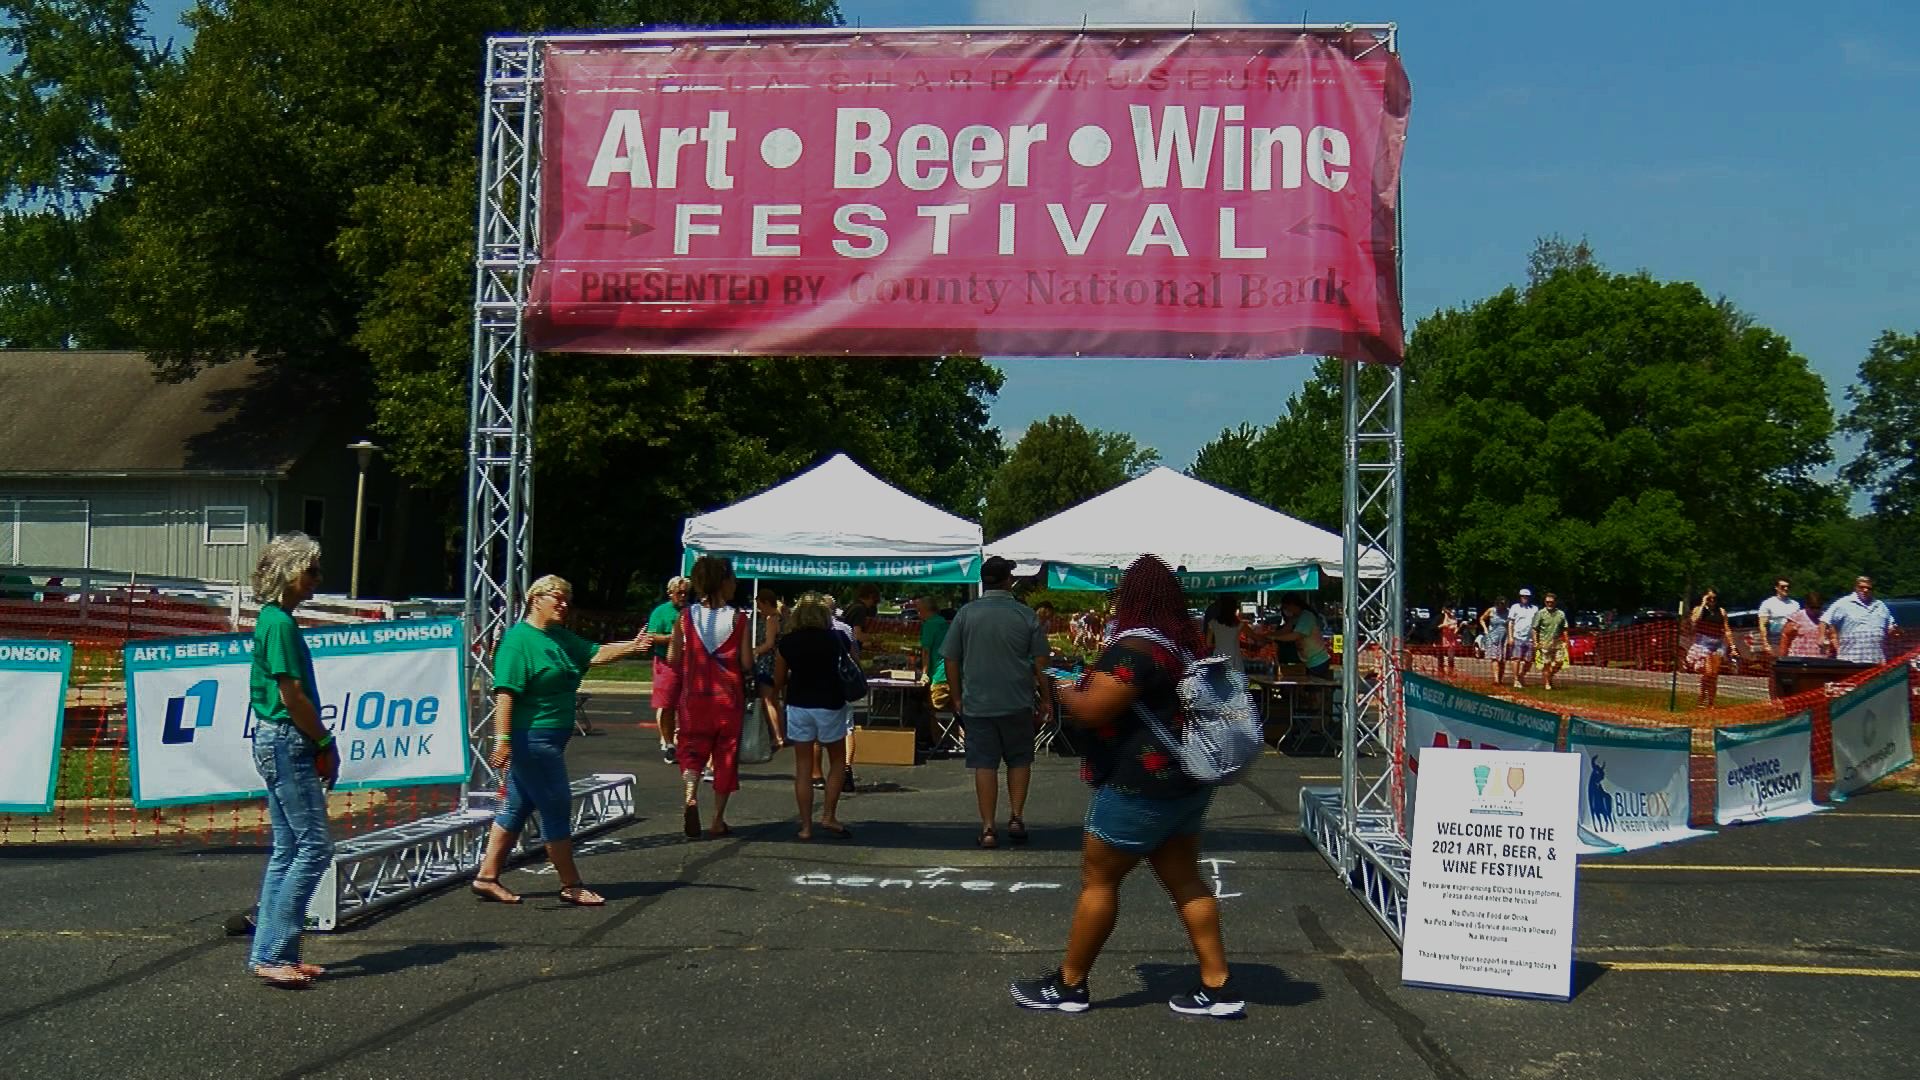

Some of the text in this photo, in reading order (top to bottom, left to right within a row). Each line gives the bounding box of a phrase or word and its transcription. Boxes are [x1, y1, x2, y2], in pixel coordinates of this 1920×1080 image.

[827, 69, 1014, 94] SHARP
[1057, 69, 1300, 92] MUSEUM
[587, 104, 1351, 192] Art Beer Wine
[673, 203, 1268, 258] FESTIVAL
[581, 267, 1352, 314] PRESENTED BY County National Bank
[743, 557, 850, 576] PURCHASED
[856, 561, 869, 576] A
[874, 560, 936, 576] TICKET
[1206, 575, 1217, 589] A
[1222, 572, 1277, 588] TICKET
[304, 624, 454, 648] ESTIVAL SPONSOR
[134, 647, 172, 662] ART,
[1477, 701, 1516, 723] FESTIVAL
[1516, 712, 1557, 734] SPONSOR
[350, 734, 435, 761] BANK
[1727, 758, 1781, 790] experience
[1437, 822, 1555, 841] WELCOME TO THE
[1432, 840, 1462, 854] 2021
[1466, 842, 1497, 859] ART,
[1547, 847, 1557, 861] &
[794, 868, 1061, 893] center
[1442, 859, 1543, 879] WINE FESTIVAL
